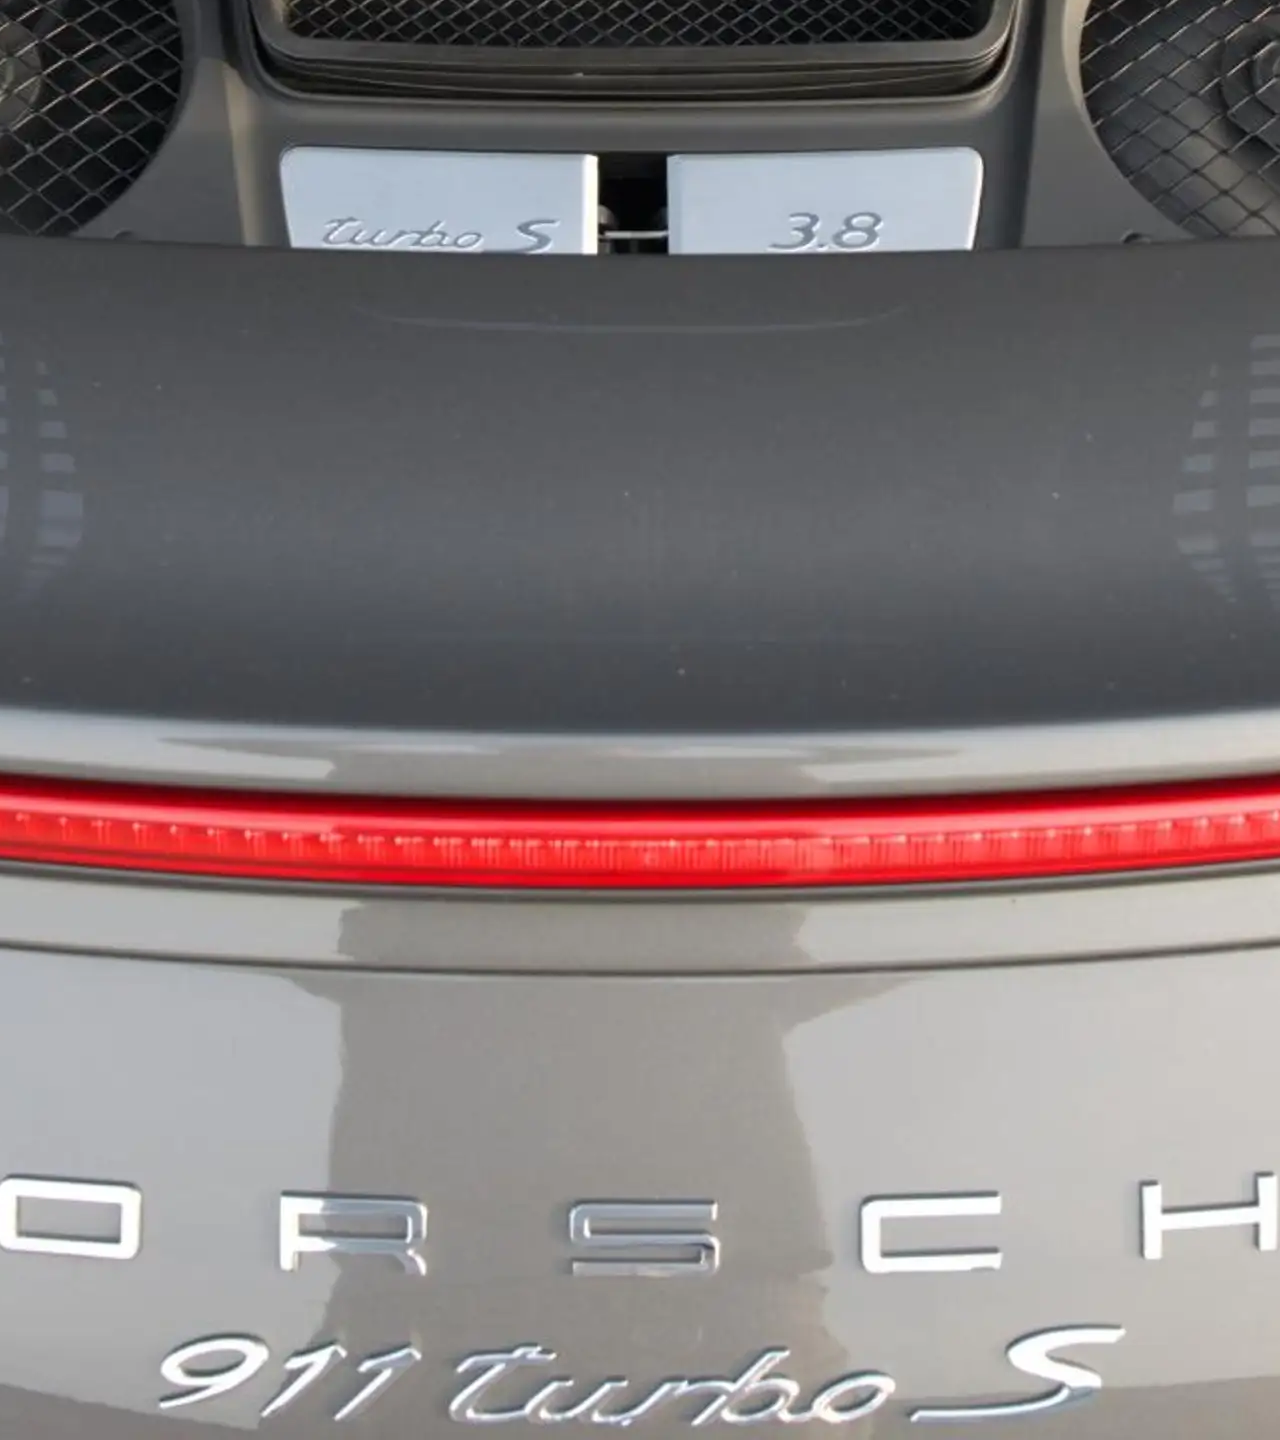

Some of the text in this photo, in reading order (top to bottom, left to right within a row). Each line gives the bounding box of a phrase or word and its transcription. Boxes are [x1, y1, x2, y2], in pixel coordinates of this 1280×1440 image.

[321, 216, 562, 254] turbo S
[768, 212, 884, 251] 3.8
[158, 1325, 1128, 1428] 911 turbo S
